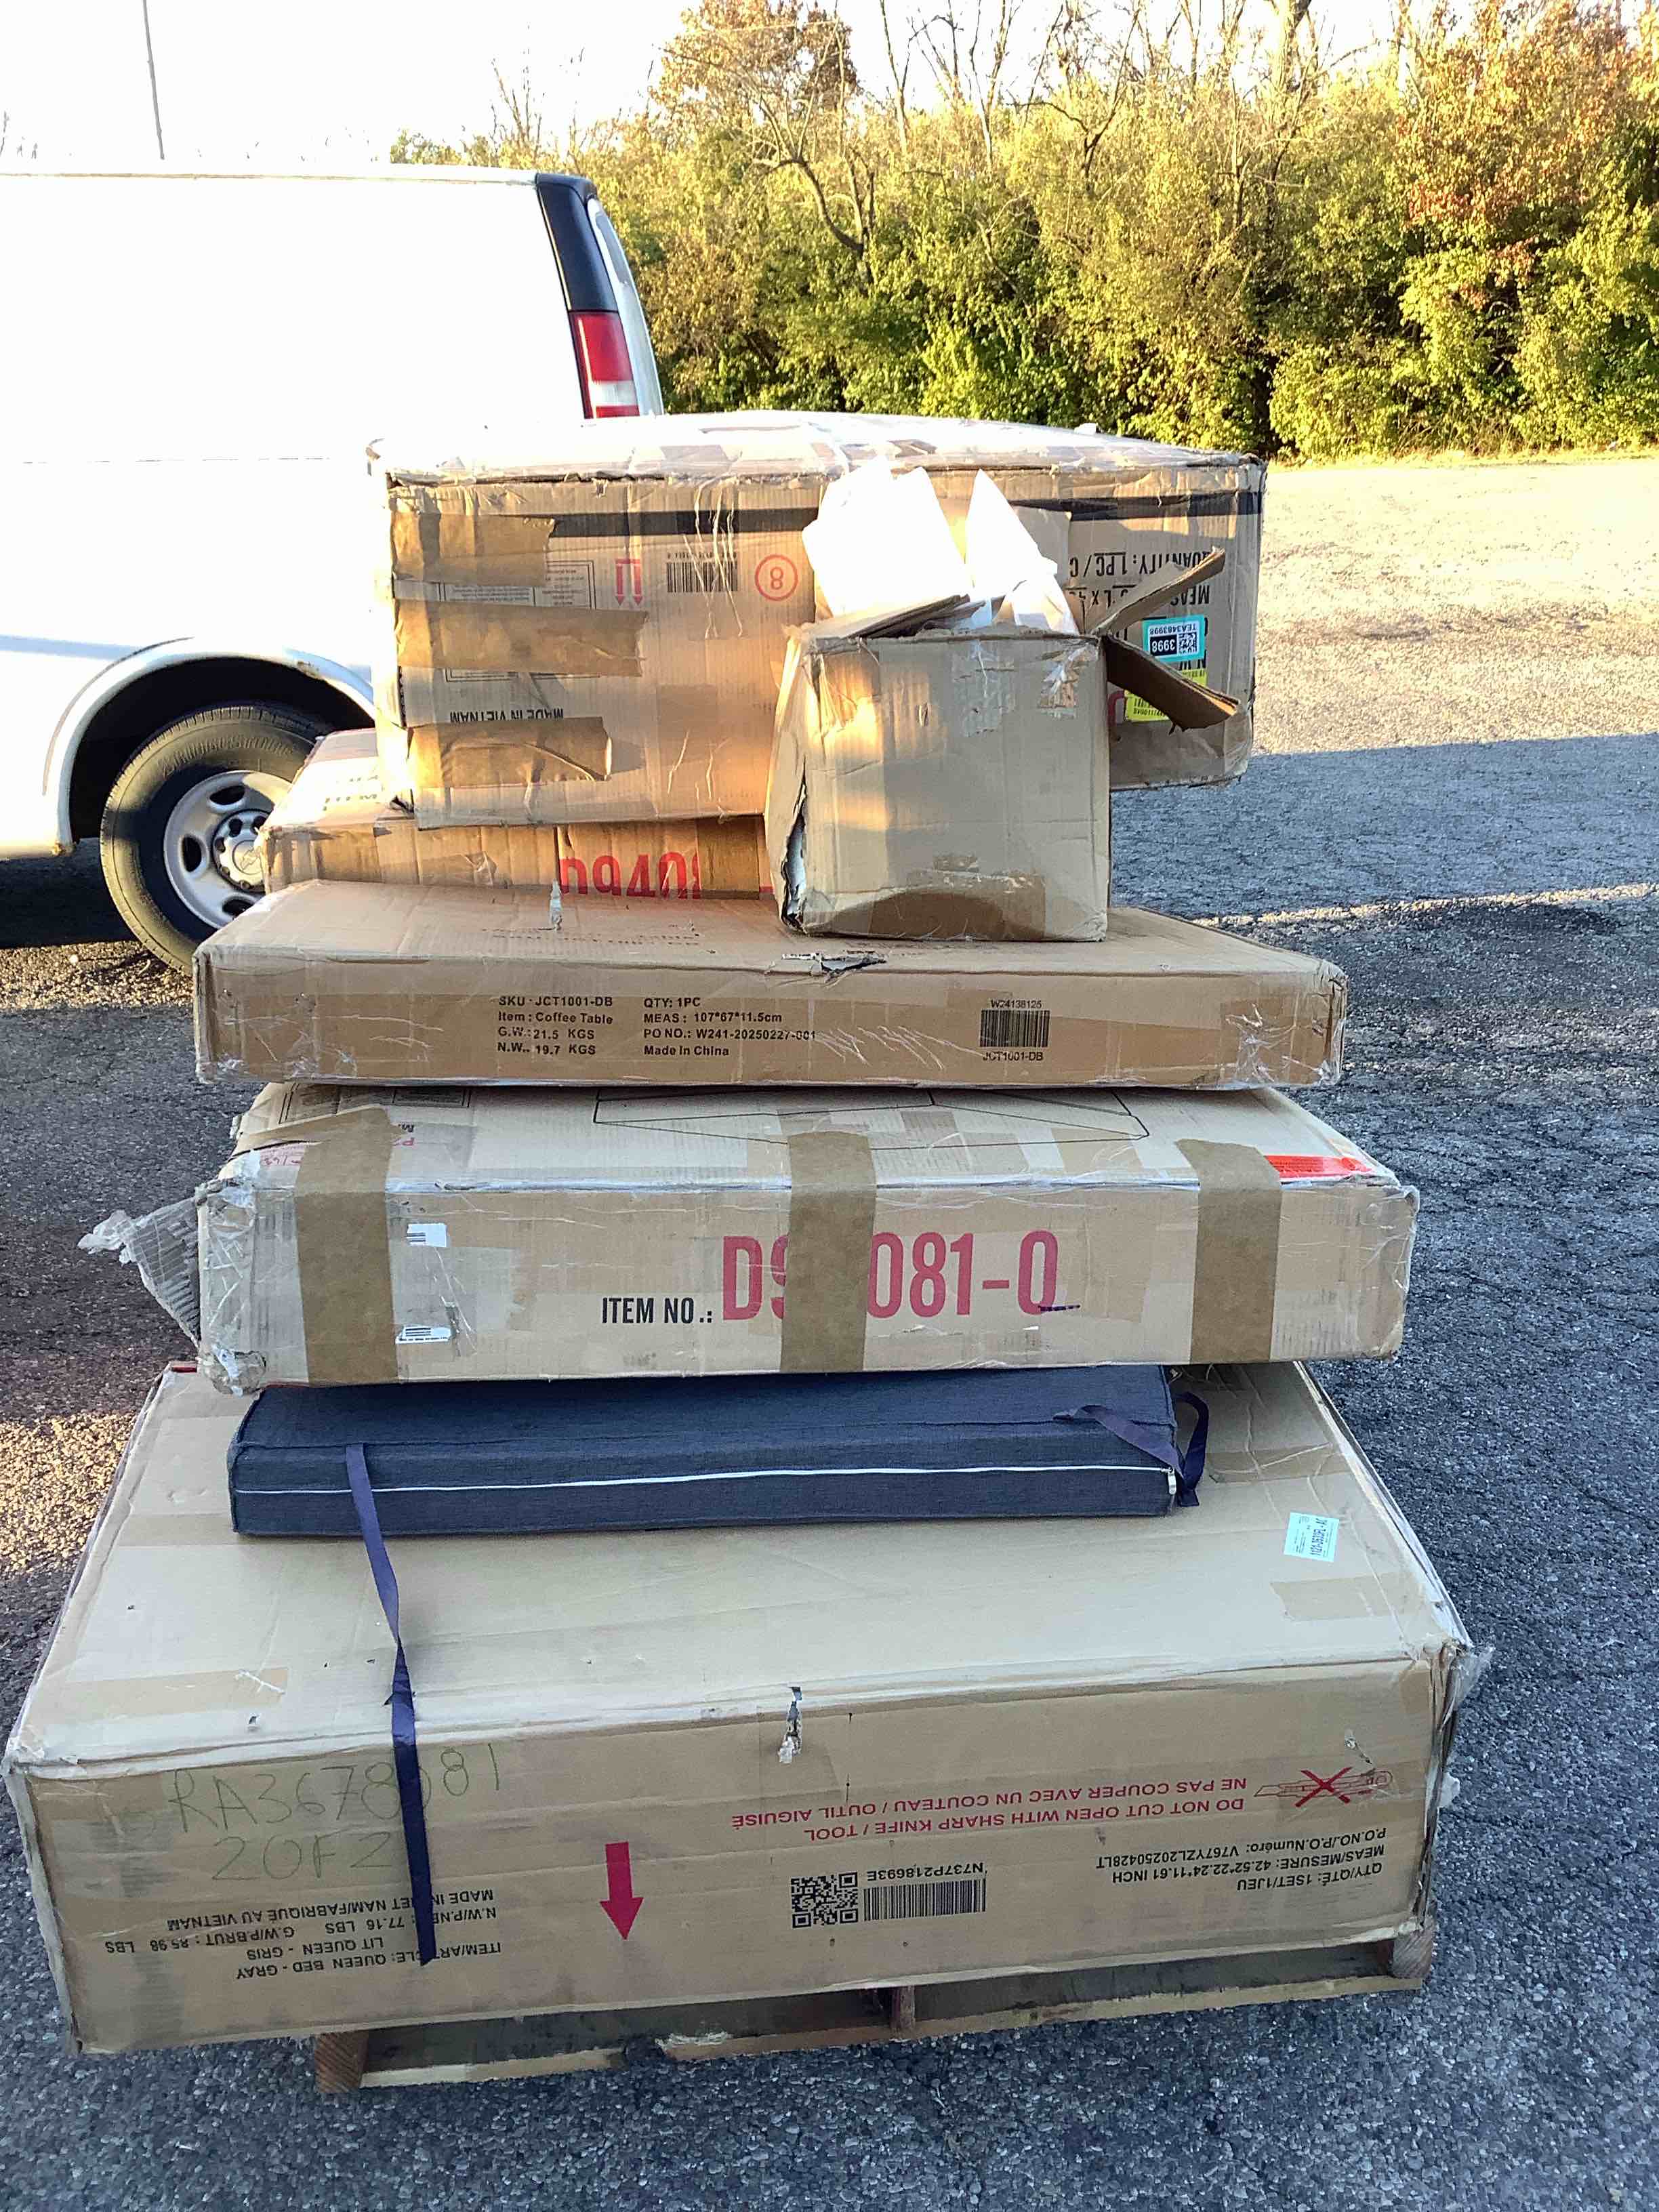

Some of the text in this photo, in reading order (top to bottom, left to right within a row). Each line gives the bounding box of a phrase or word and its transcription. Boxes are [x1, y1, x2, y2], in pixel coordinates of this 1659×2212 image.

[1152, 639, 1175, 652] 3998
[499, 996, 525, 1006] SKU
[535, 997, 613, 1006] JCT1001-DB
[644, 998, 701, 1008] QTY: 1PC
[499, 1011, 525, 1021] Item
[535, 1012, 576, 1022] Coffee
[580, 1013, 613, 1024] Table
[533, 1029, 558, 1039] 21.5
[568, 1029, 594, 1039] KGS
[644, 1029, 661, 1038] PO
[665, 1028, 691, 1038] NO.:
[536, 1046, 560, 1054] 19.7
[569, 1044, 596, 1054] KGS
[644, 1046, 676, 1055] Made
[694, 1046, 729, 1055] China
[983, 1052, 1043, 1061] JCT1001-DB
[602, 1297, 655, 1324] ITEM
[722, 1231, 1059, 1321] D081-0
[1088, 1783, 1169, 1799] COUPER
[1176, 1780, 1214, 1793] PAS
[1221, 1778, 1247, 1790] NE
[996, 1792, 1022, 1805] UN
[1029, 1788, 1082, 1803] AVEC
[894, 1795, 989, 1812] COUTEAU
[1126, 1803, 1164, 1817] CUT
[1170, 1800, 1210, 1814] NOT
[1216, 1799, 1244, 1811] DO
[818, 1803, 876, 1819] OUTIL
[1011, 1810, 1059, 1824] WITH
[1065, 1806, 1120, 1820] OPEN
[731, 1809, 813, 1830] AIGUISÉ
[938, 1814, 1005, 1830] SHARP
[803, 1824, 858, 1841] TOOL
[874, 1819, 932, 1835] KNIFE
[1276, 1844, 1385, 1868] MEAS/MESURE:
[867, 1862, 984, 1881] N737P218693E
[1112, 1870, 1147, 1883] INCH
[1237, 1862, 1382, 1891] QTY/QTÉ: 1SET/1JEU
[449, 1889, 493, 1904] MADE
[167, 1913, 237, 1931] VIETNAM
[241, 1910, 262, 1923] AU
[432, 1907, 496, 1925] N.W/P.NE
[325, 1921, 355, 1934] LBS
[104, 1941, 134, 1953] LBS
[302, 1939, 356, 1955] QUEEN
[361, 1937, 384, 1950] LIT
[246, 1946, 283, 1961] GRIS
[292, 1961, 324, 1973] BED
[332, 1953, 386, 1969] QUEEN
[236, 1964, 277, 1980] GRAY
